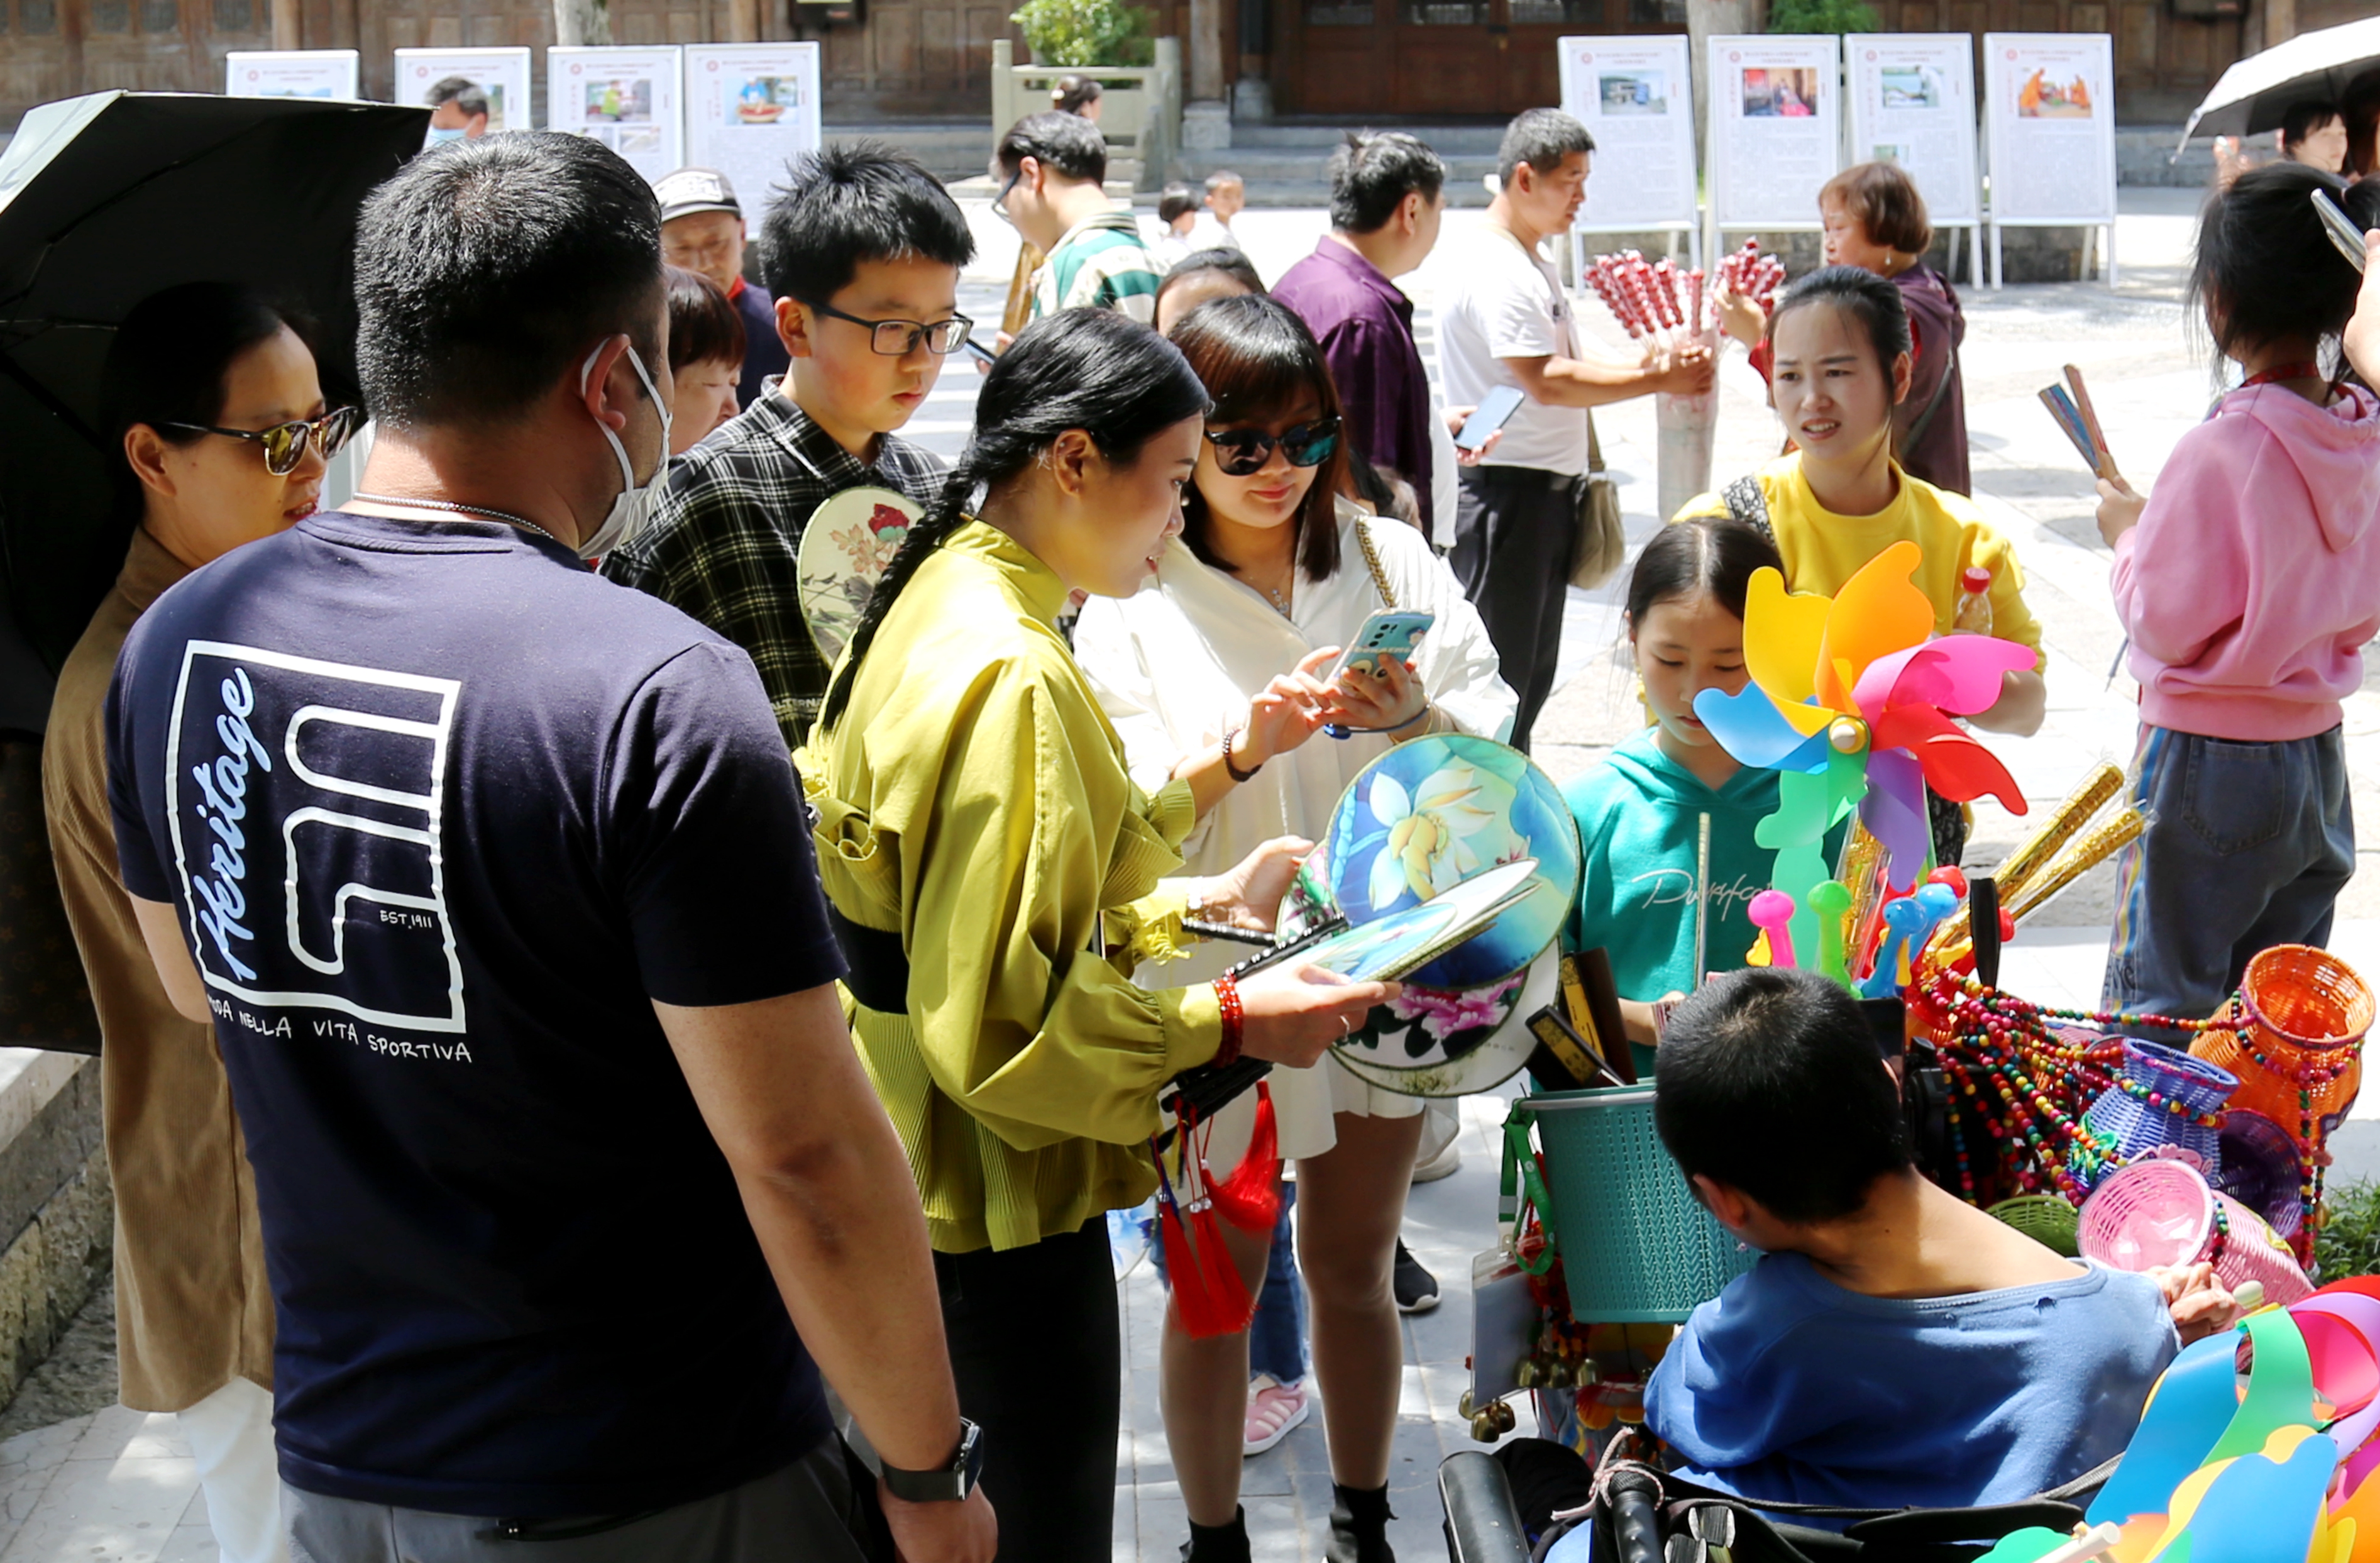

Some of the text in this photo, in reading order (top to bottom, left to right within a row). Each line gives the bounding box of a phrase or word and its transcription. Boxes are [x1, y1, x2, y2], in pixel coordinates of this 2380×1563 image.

[191, 666, 272, 980] Heritage
[239, 1010, 292, 1039] NELLA
[314, 1019, 359, 1044] VITA
[367, 1034, 473, 1063] SPORTIVA
